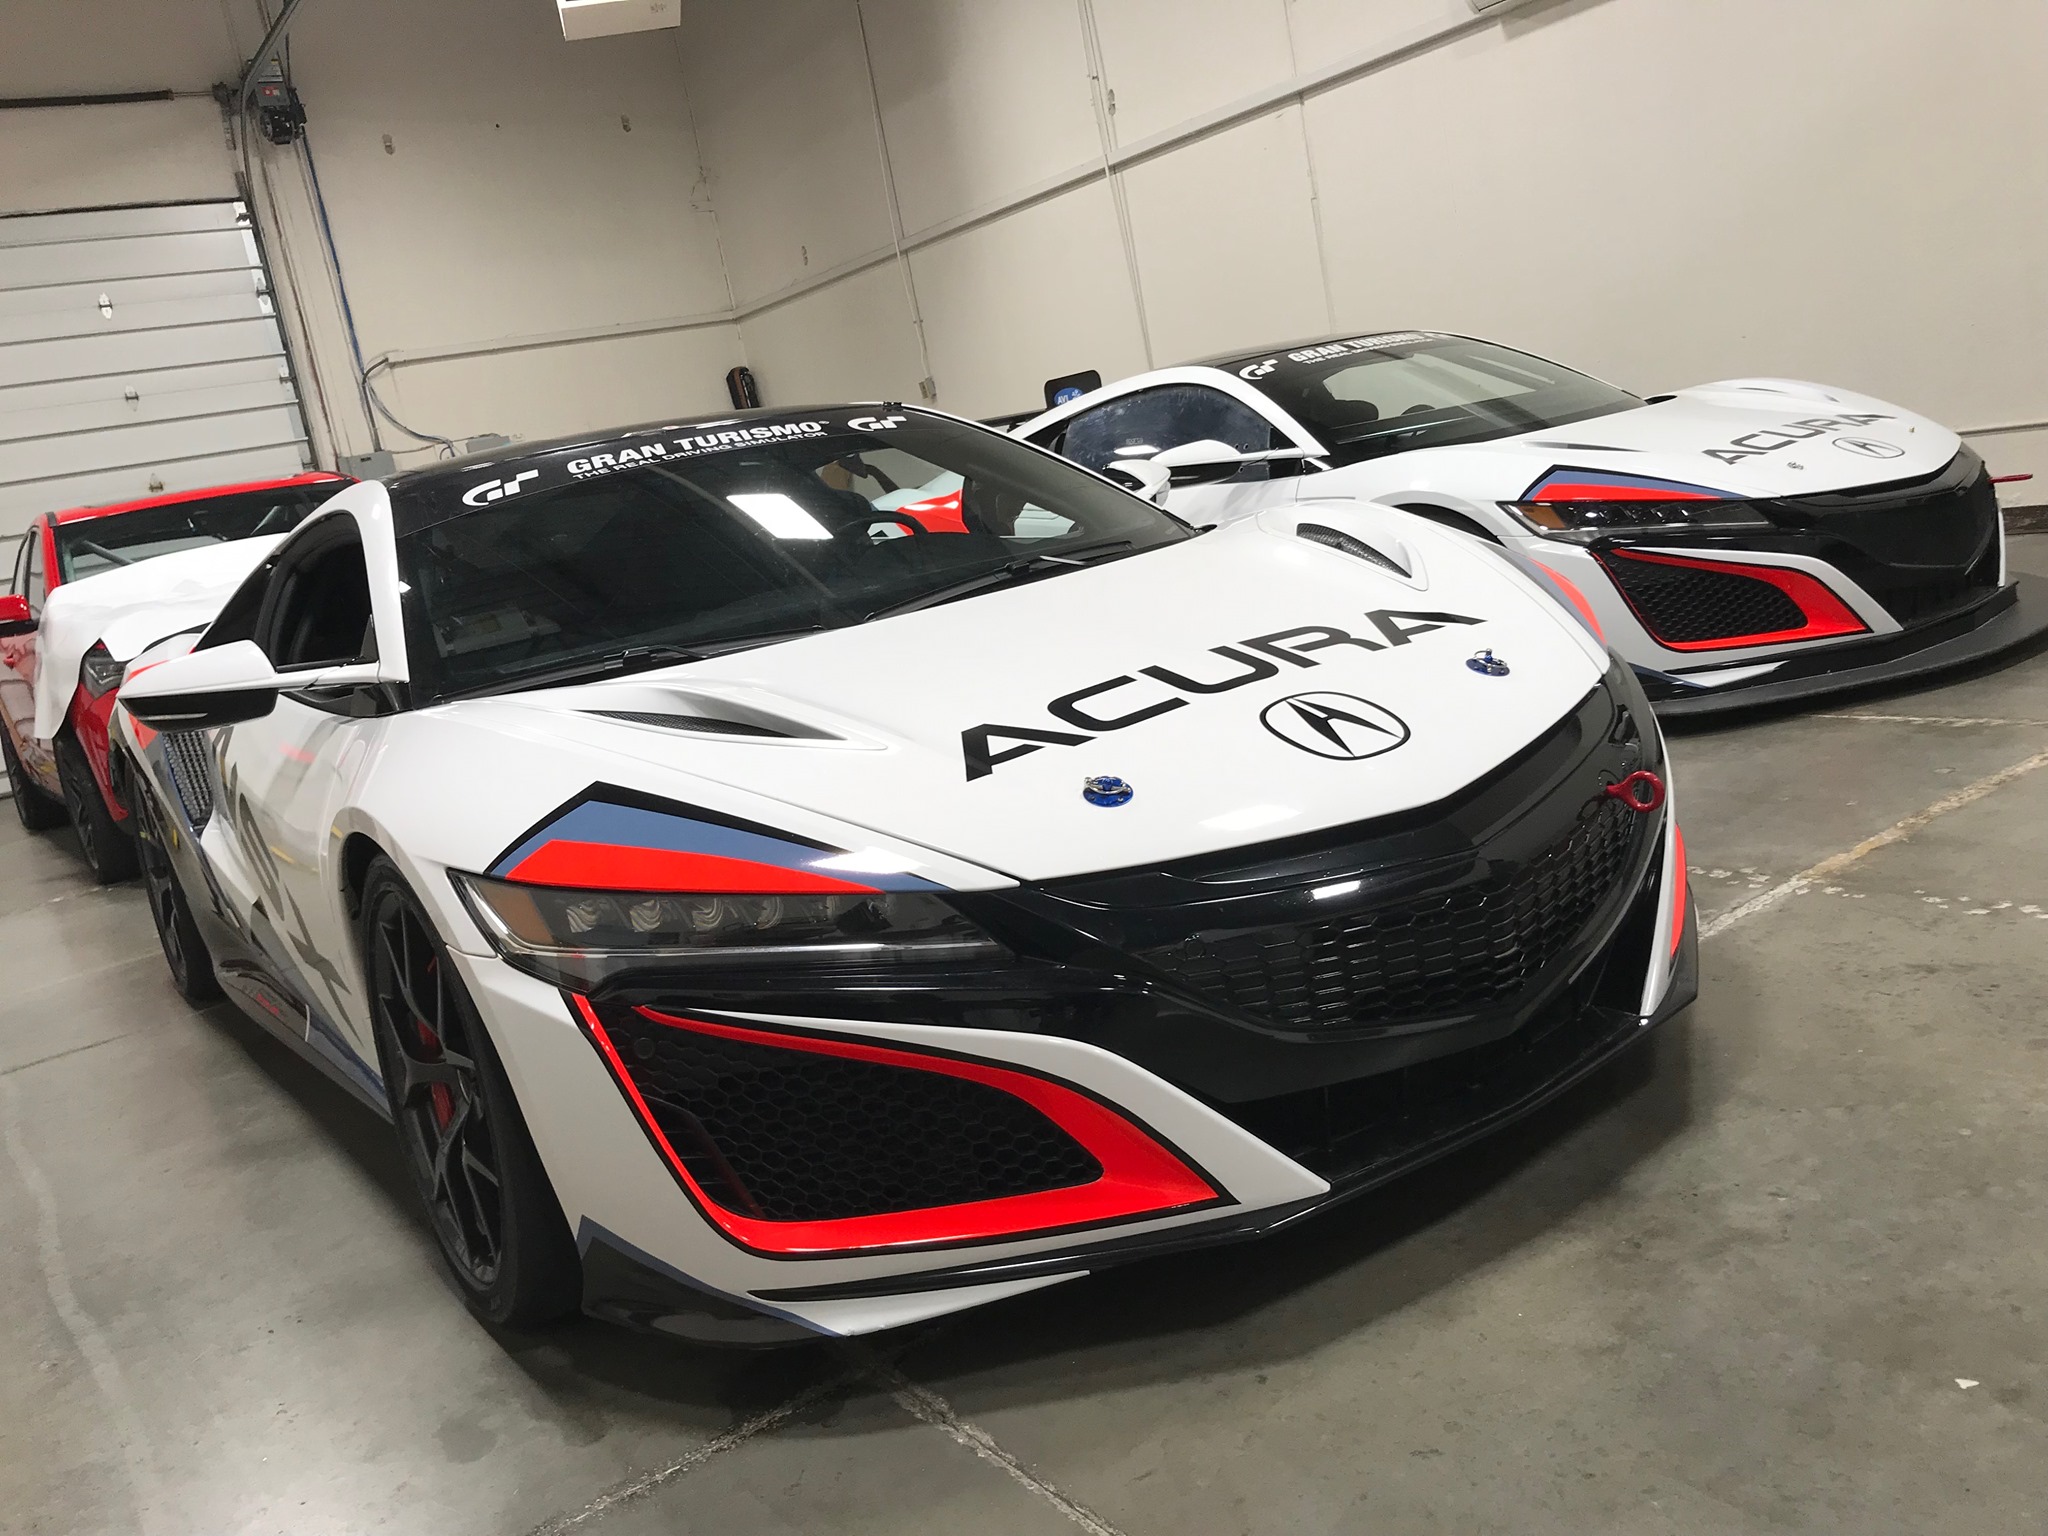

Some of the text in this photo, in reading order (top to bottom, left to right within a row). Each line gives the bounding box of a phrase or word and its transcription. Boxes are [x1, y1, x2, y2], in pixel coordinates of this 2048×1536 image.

[1287, 344, 1349, 362] GRAN
[566, 442, 667, 475] GRAN
[572, 430, 828, 480] THE REAL DRIVING SIMULATOR
[1701, 413, 1897, 465] ACURA
[960, 608, 1488, 783] ACURA
